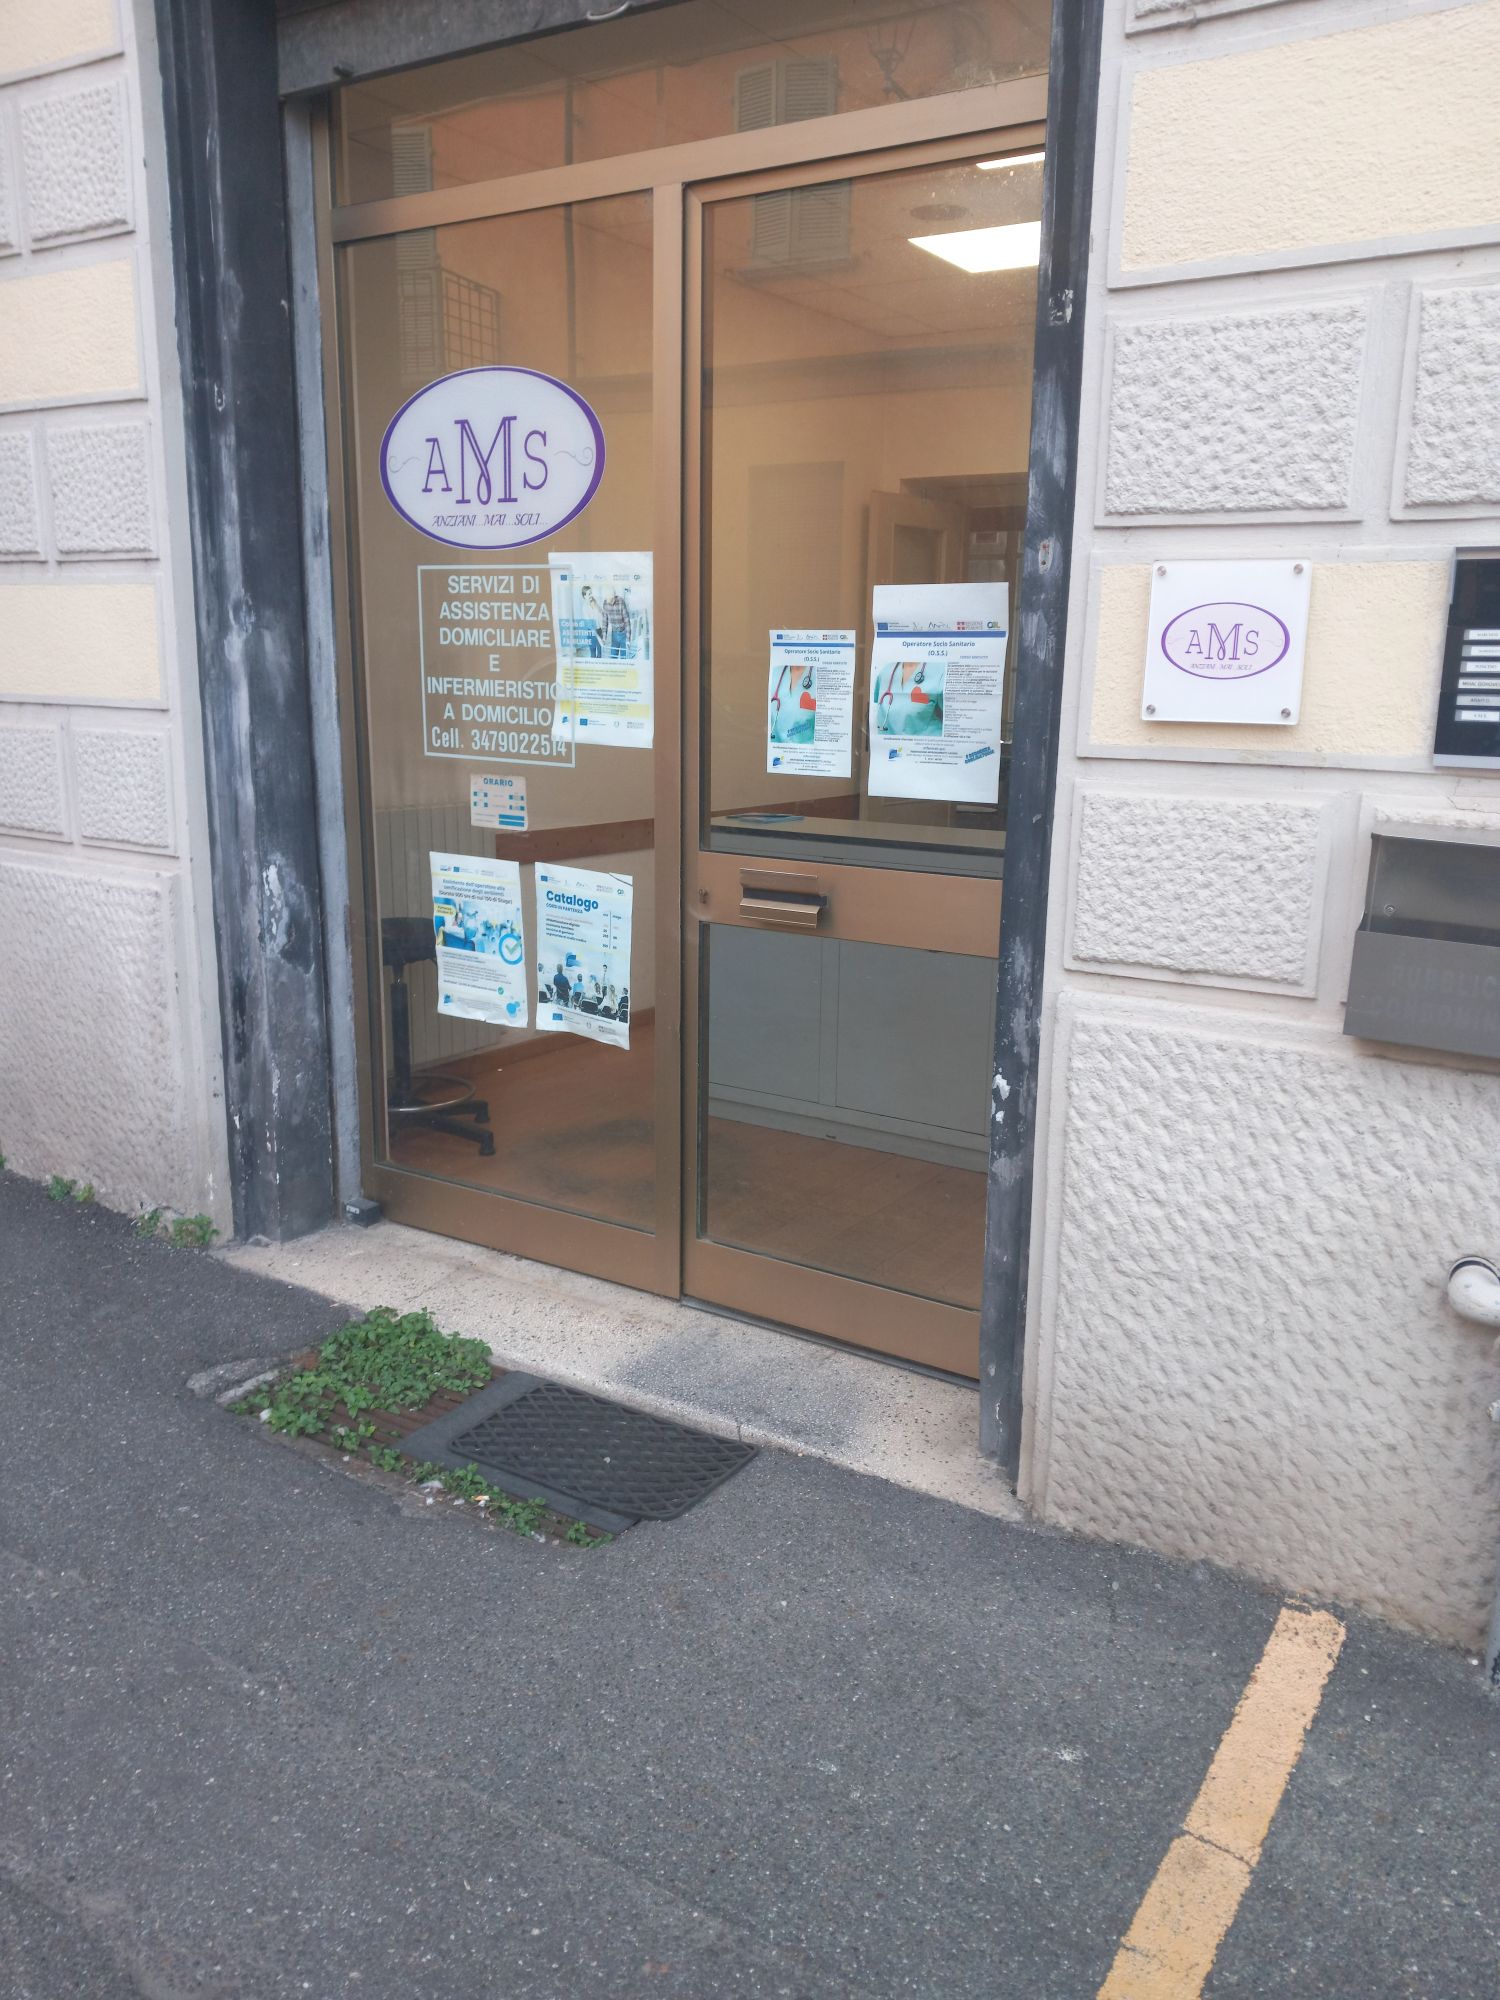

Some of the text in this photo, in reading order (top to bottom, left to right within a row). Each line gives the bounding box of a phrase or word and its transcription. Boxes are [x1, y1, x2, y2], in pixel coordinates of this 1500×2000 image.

[422, 416, 548, 505] AMS
[447, 575, 540, 594] SERVIZI DI
[439, 601, 550, 621] ASSISTENZA
[439, 627, 551, 648] DOMICILIARE
[1185, 622, 1259, 661] AMS
[489, 654, 500, 672] E
[443, 703, 551, 727] A DOMICILIO
[431, 726, 567, 756] Cell. 3479022514
[483, 777, 513, 787] ORARIO
[546, 890, 599, 912] Catalogo
